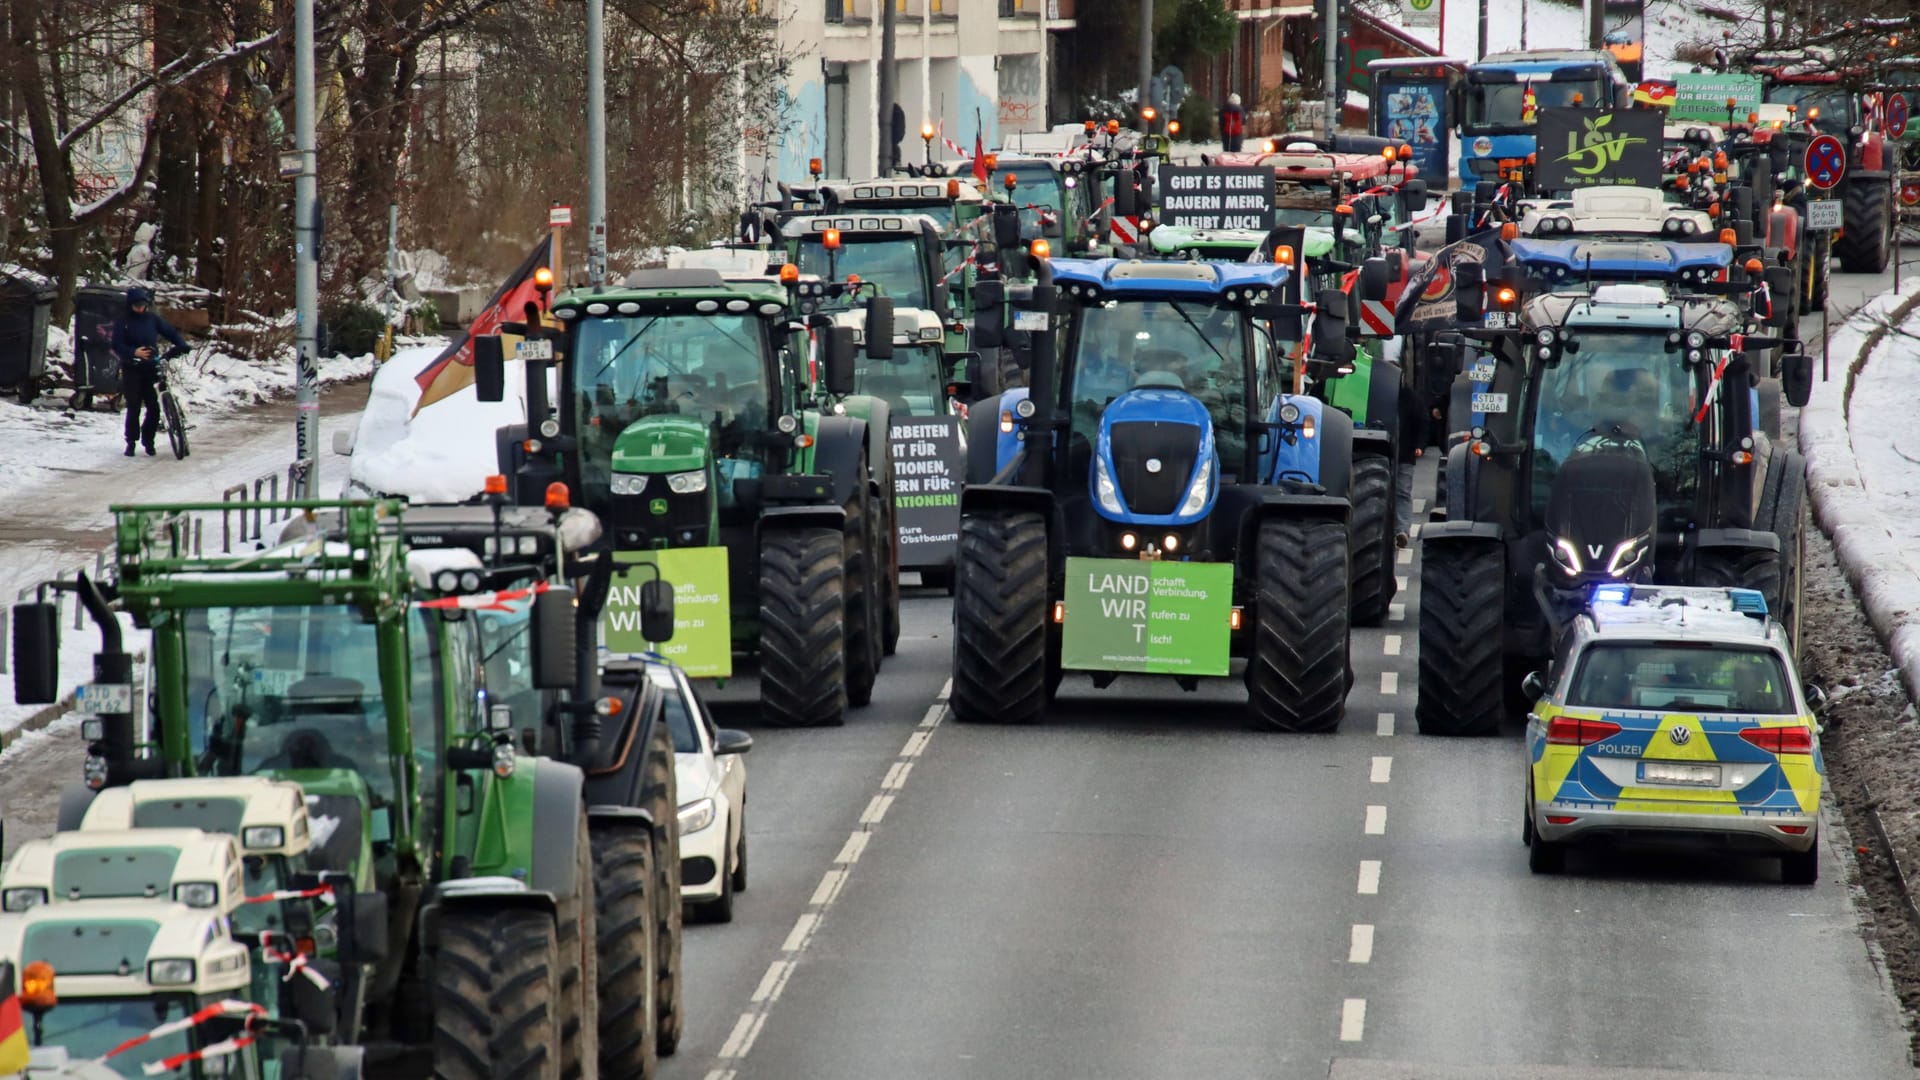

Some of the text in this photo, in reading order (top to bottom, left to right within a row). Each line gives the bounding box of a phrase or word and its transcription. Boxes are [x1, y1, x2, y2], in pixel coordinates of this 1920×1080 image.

[1171, 175, 1264, 189] GIBT ES KEINE
[1165, 195, 1269, 212] BAUERN MEHR,
[1224, 215, 1260, 229] AUCH
[1478, 394, 1495, 403] STD
[910, 440, 936, 457] FÜR
[899, 526, 922, 535] Eure
[900, 533, 958, 544] Obstbauern
[1089, 572, 1149, 595] LAND
[1153, 576, 1186, 588] schafft
[606, 585, 641, 606] AN
[673, 593, 720, 604] rbindung.
[1152, 587, 1208, 600] Verbindung.
[1101, 598, 1146, 619] WIR
[609, 610, 643, 631] WI
[1152, 611, 1191, 621] rufen zu
[692, 619, 704, 628] zu
[1133, 623, 1146, 643] T
[1597, 743, 1642, 755] POLIZEI
